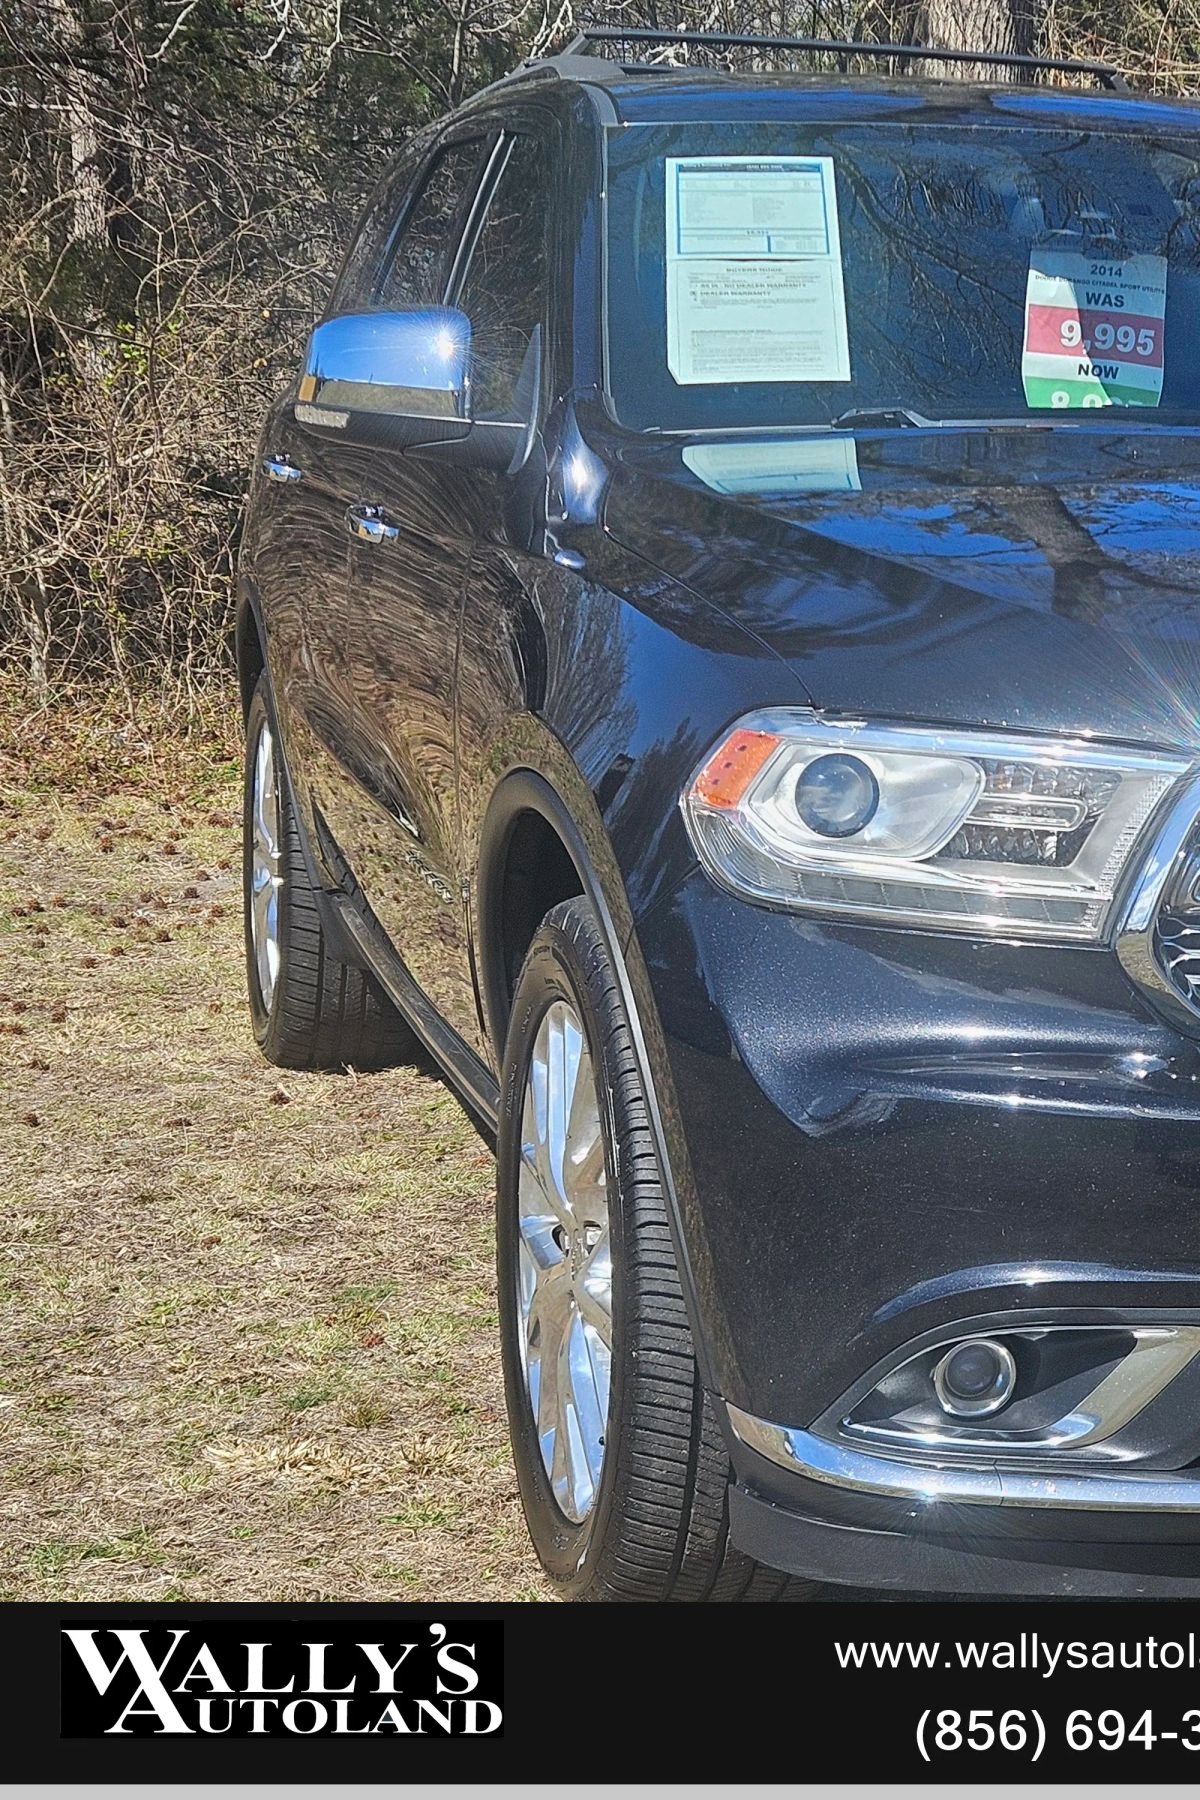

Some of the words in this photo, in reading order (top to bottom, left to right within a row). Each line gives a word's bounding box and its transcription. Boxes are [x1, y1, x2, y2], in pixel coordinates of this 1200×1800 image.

[1090, 264, 1123, 278] 2014
[1092, 280, 1119, 289] CITADEL
[1120, 283, 1141, 291] SPORT
[1085, 292, 1125, 308] WAS
[1060, 319, 1155, 356] 9,995
[1078, 363, 1119, 380] NOW
